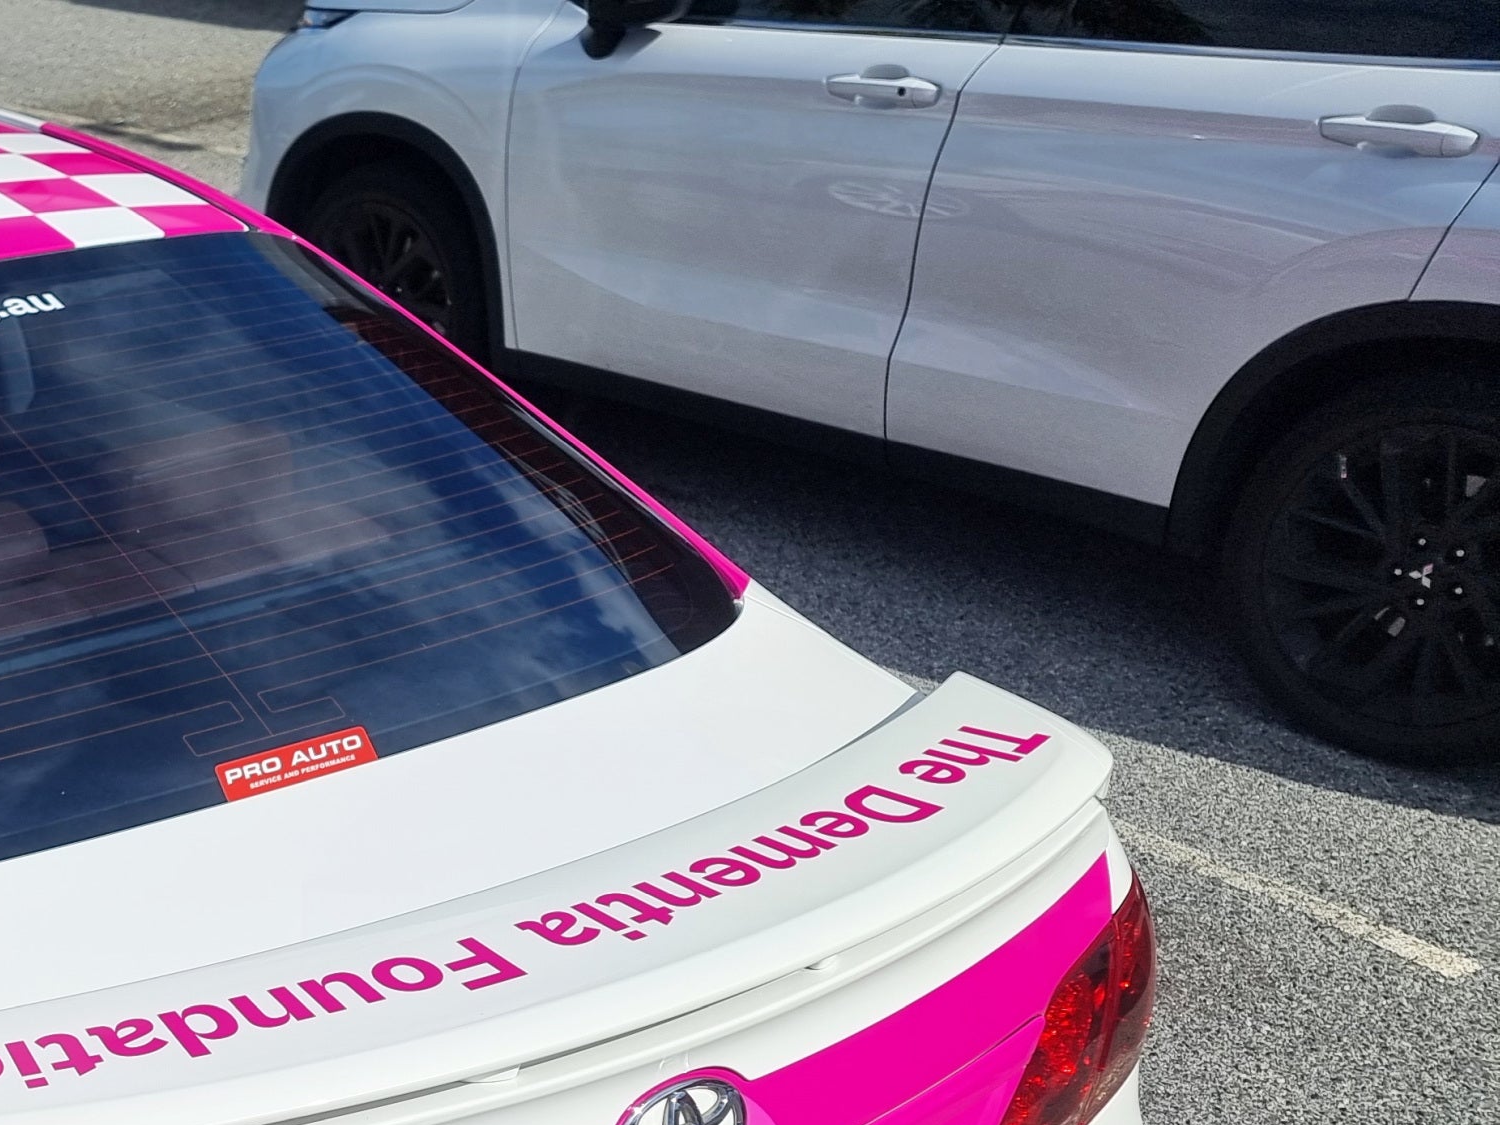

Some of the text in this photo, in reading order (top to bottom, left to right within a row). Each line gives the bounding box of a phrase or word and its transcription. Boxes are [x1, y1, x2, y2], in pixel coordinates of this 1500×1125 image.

[224, 734, 362, 785] PRO AUTO
[249, 754, 356, 790] SERVICE AND PERFORMANCE
[898, 725, 1052, 785] The
[513, 784, 945, 946] Dementia
